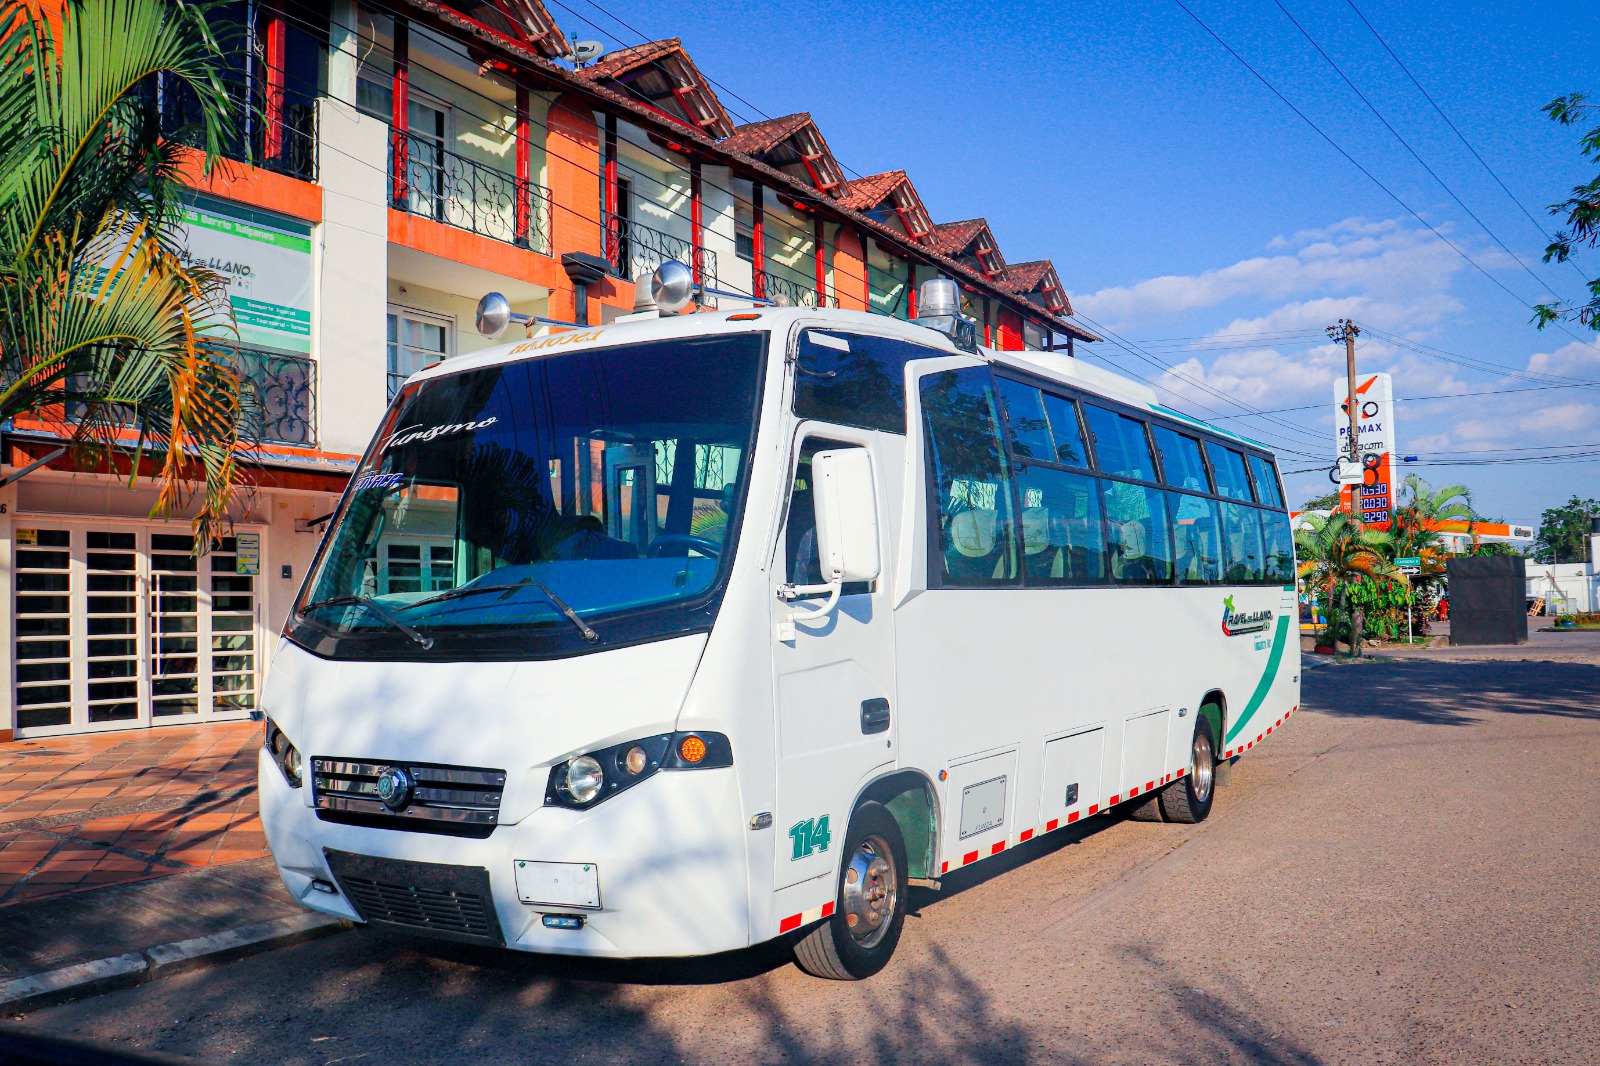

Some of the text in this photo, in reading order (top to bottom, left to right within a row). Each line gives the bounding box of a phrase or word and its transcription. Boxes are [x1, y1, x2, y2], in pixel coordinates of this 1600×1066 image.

[201, 214, 231, 230] Barrio
[234, 223, 274, 241] Tulipanes
[209, 258, 250, 276] LLANO
[1363, 511, 1388, 523] 9290
[789, 814, 832, 861] 114
